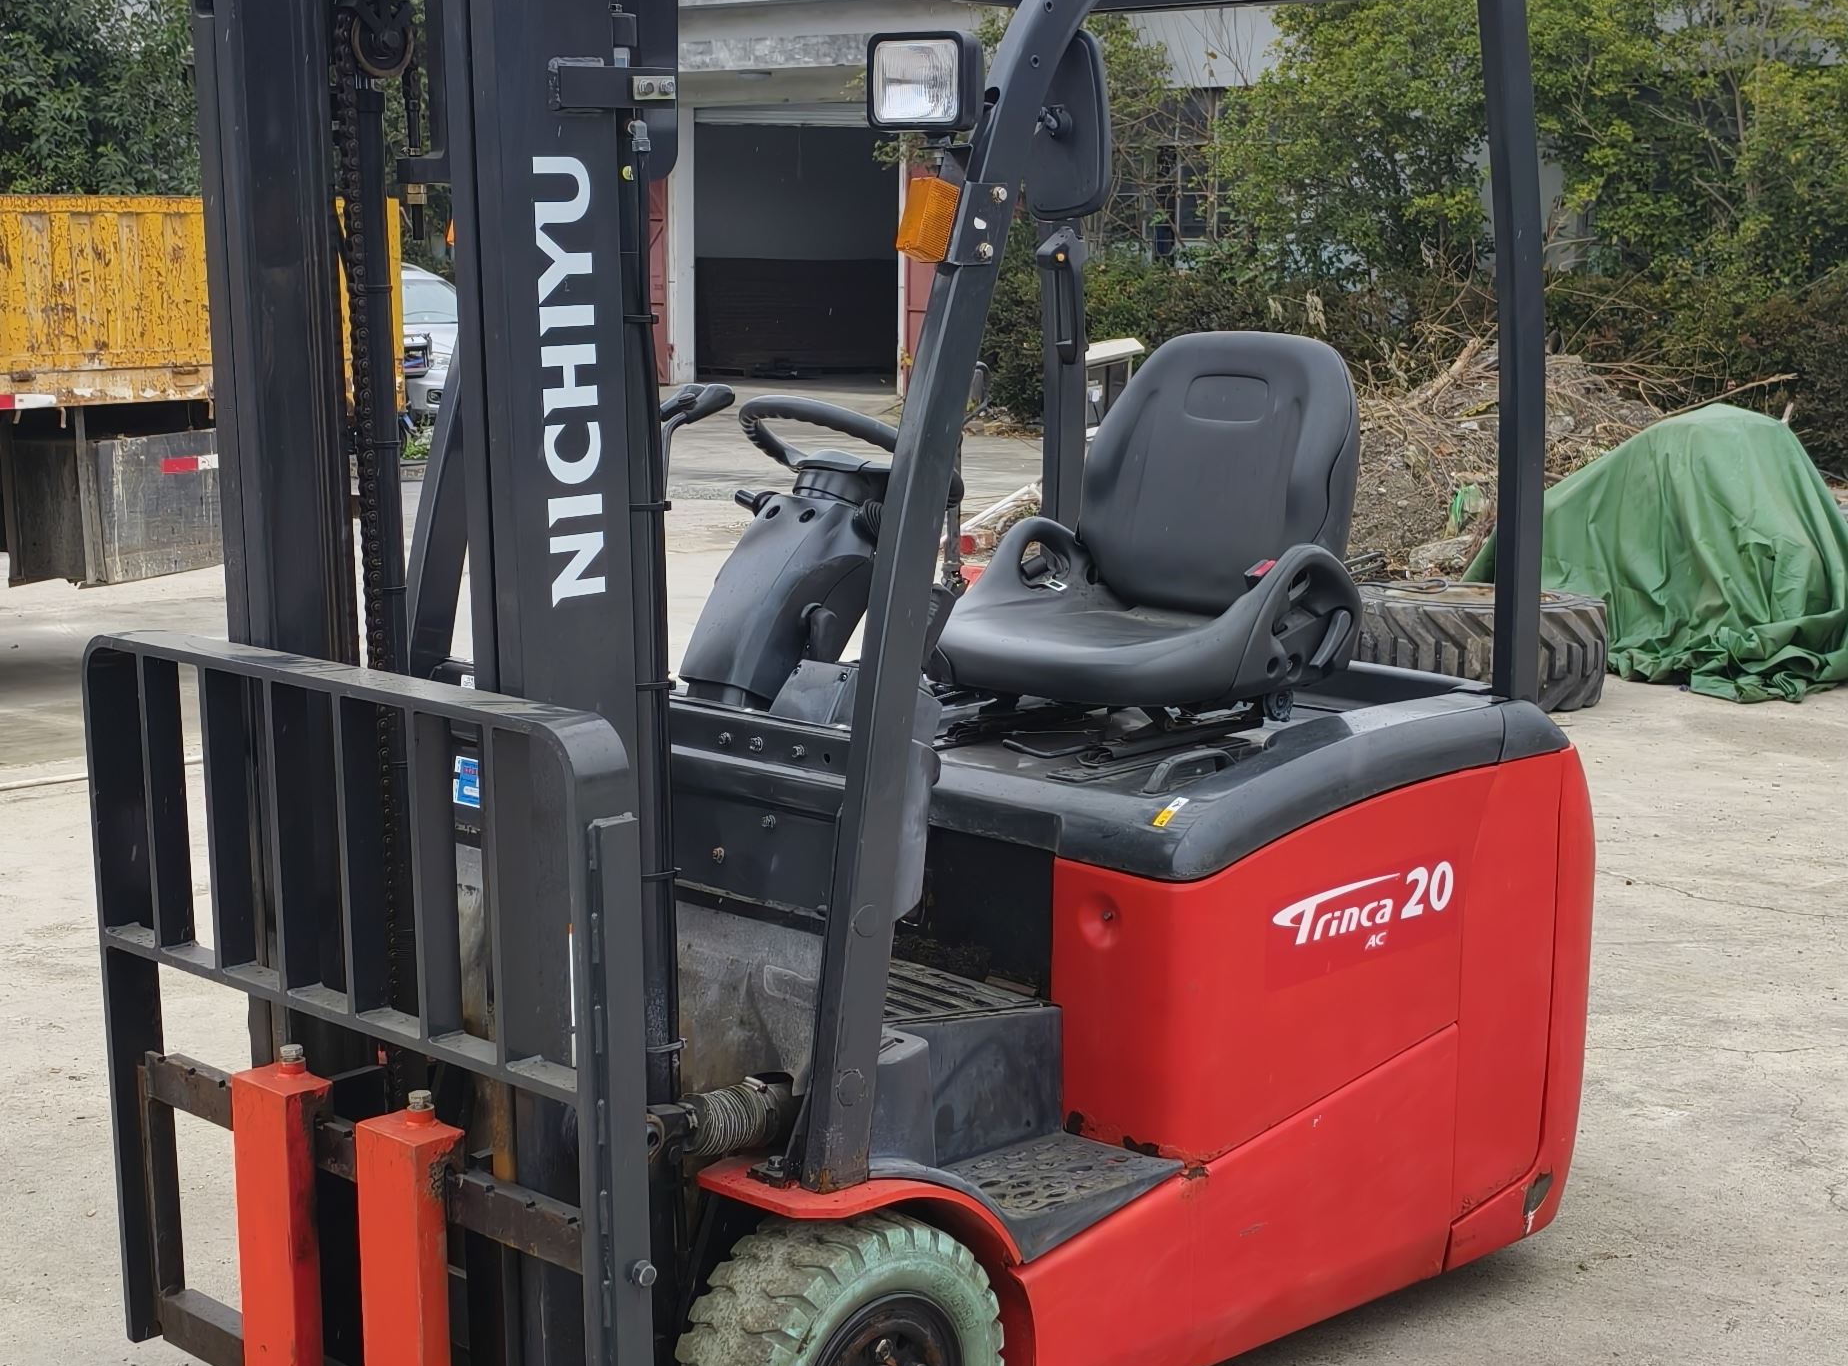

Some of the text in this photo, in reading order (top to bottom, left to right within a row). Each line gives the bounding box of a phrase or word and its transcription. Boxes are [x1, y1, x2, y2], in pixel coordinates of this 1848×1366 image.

[532, 156, 606, 607] NICHIYU
[1272, 861, 1454, 945] Trinca 20
[1364, 931, 1387, 950] AC
